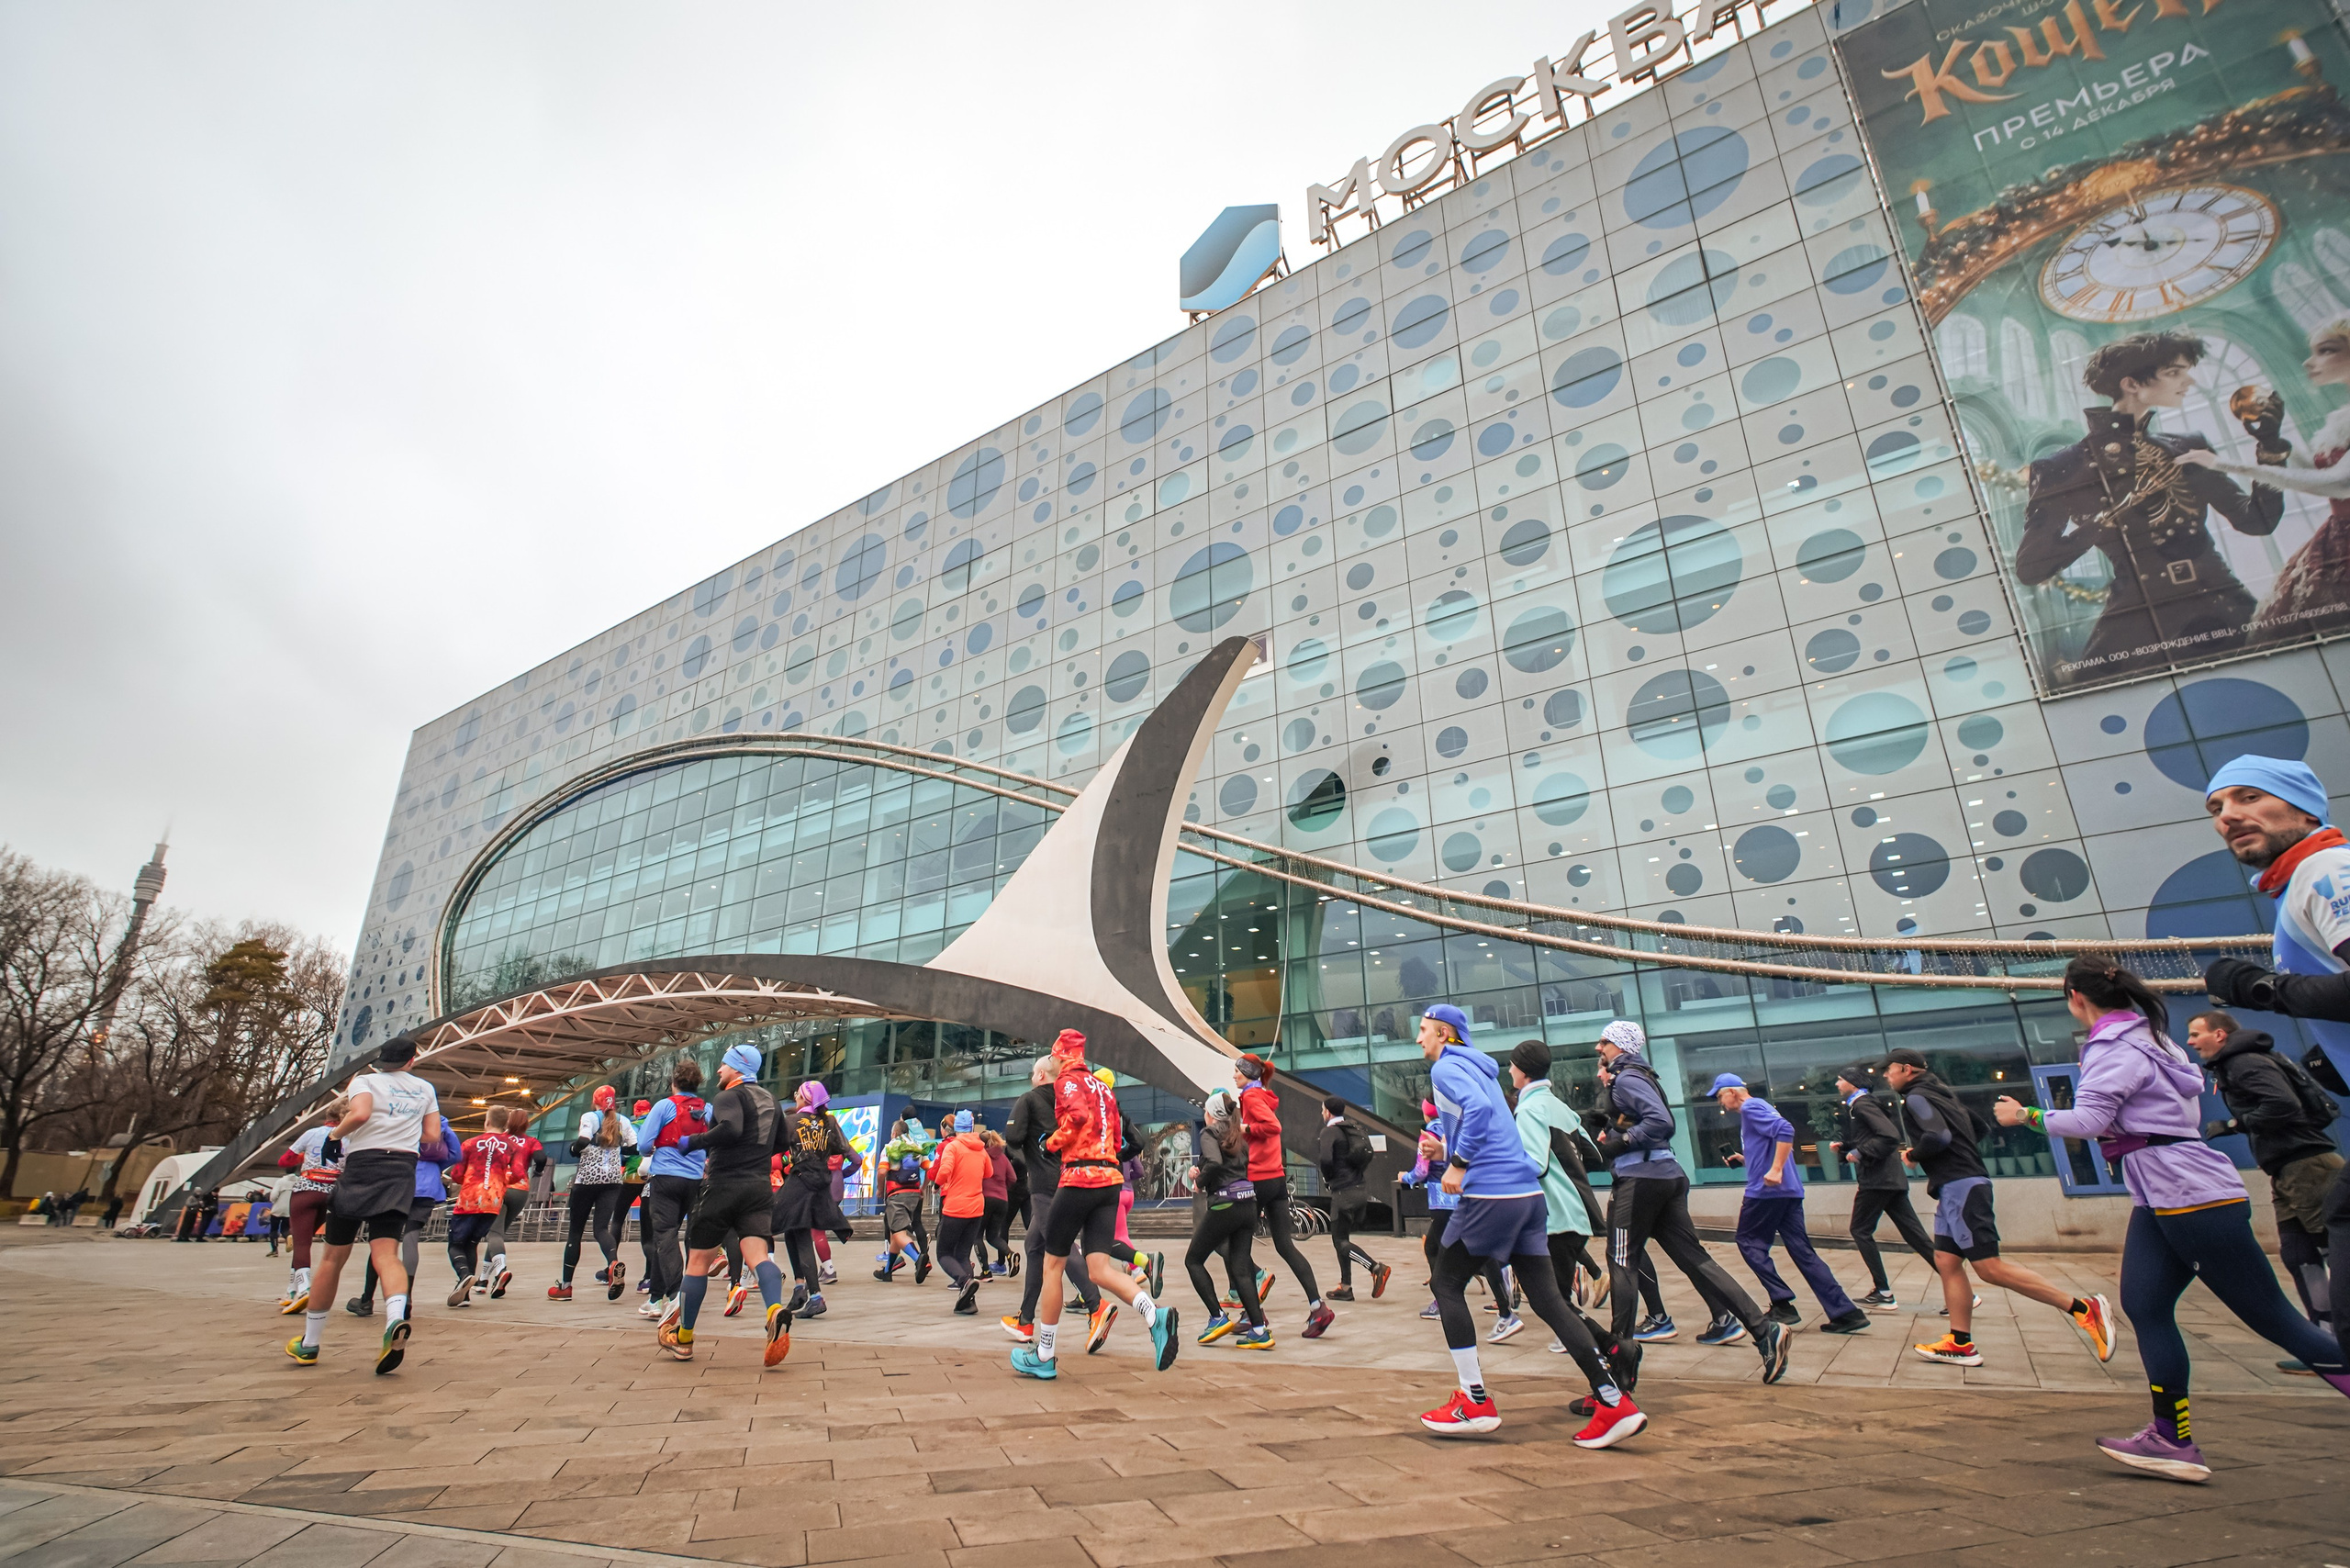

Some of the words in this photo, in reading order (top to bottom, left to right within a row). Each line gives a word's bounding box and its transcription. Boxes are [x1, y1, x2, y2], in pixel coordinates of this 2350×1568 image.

[1973, 42, 2210, 151] ПРЕМЬЕРА
[2020, 137, 2037, 151] С
[2042, 126, 2065, 140] 14
[2072, 77, 2177, 130] ДЕКАБРЯ
[2109, 650, 2130, 662] ООО
[2131, 632, 2210, 655] «ВОЗРОЖДЕНИЕ
[2241, 621, 2269, 633] ОГРН
[2330, 894, 2350, 911] RU
